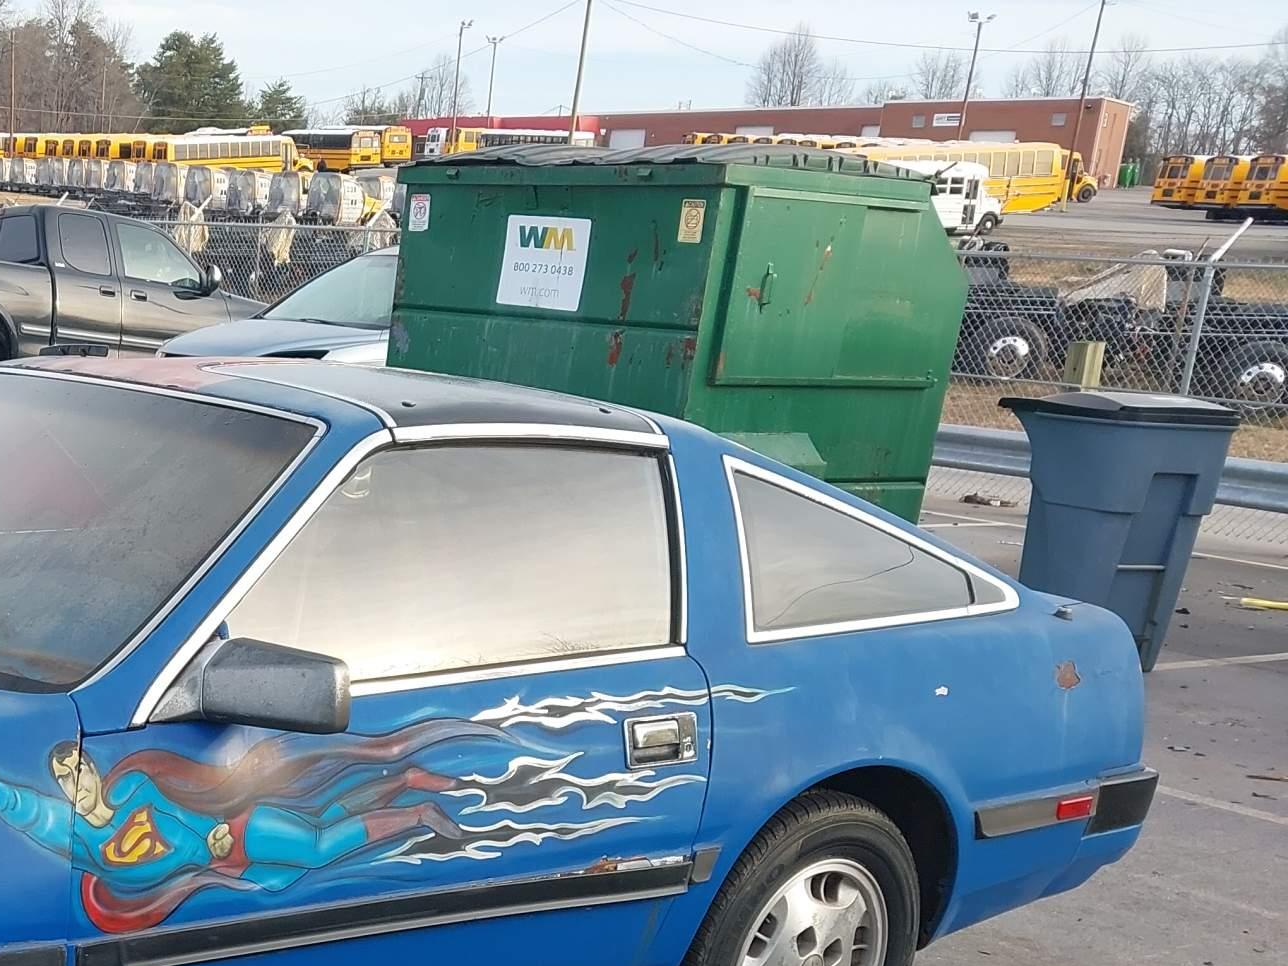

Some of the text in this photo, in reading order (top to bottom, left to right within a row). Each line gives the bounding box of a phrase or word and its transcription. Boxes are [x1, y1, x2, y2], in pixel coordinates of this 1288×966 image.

[519, 225, 576, 251] WM
[513, 262, 574, 276] 800 273 0438
[520, 286, 560, 298] wm.com
